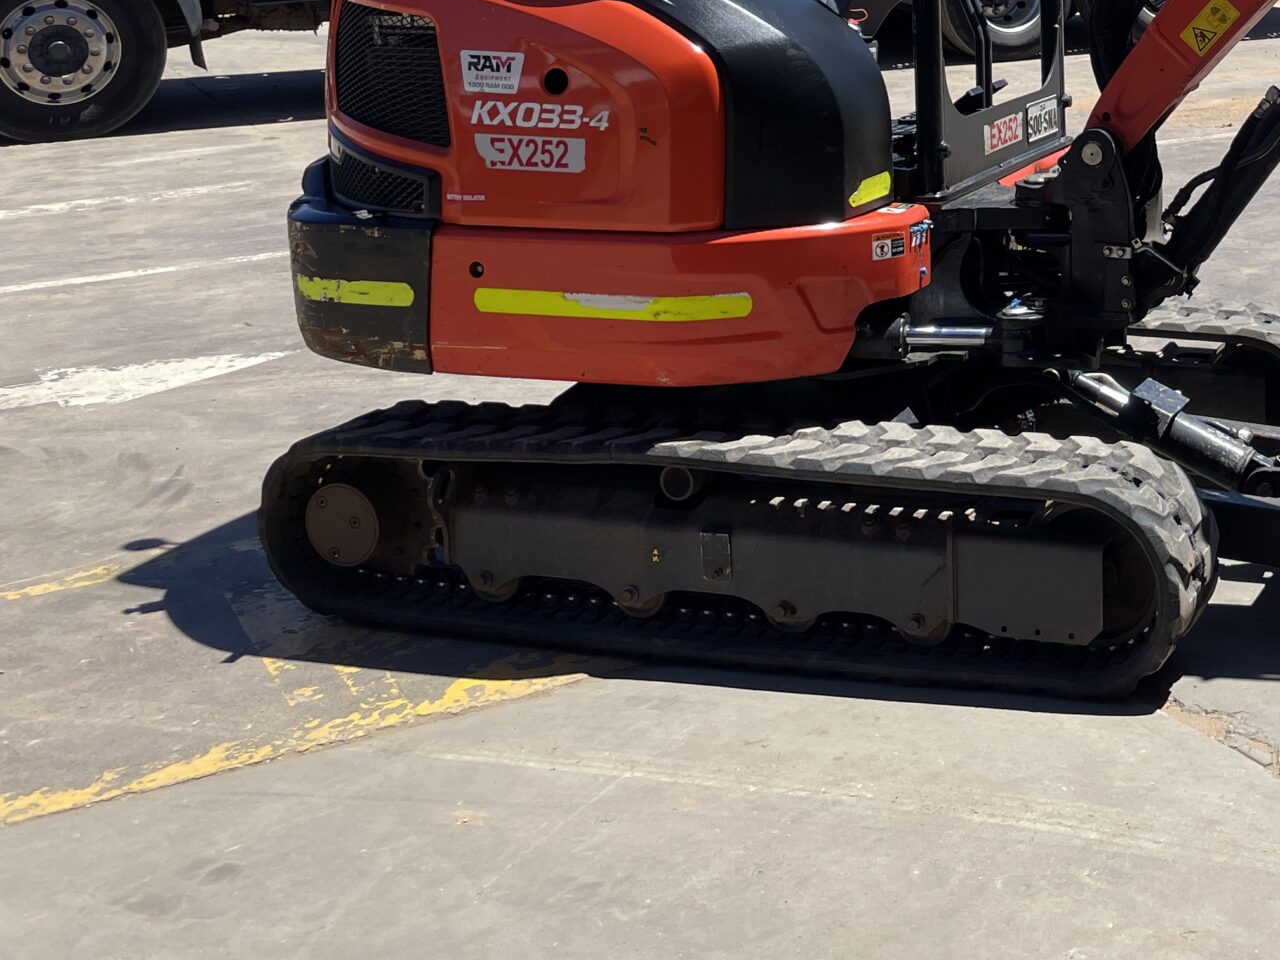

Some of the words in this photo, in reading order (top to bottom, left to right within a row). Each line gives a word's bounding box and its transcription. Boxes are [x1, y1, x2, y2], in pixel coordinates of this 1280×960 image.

[467, 54, 516, 73] RAM
[474, 73, 511, 81] EQUIPMENT
[470, 100, 610, 131] KX033-4
[989, 115, 1019, 150] EX252
[489, 136, 569, 169] EX252
